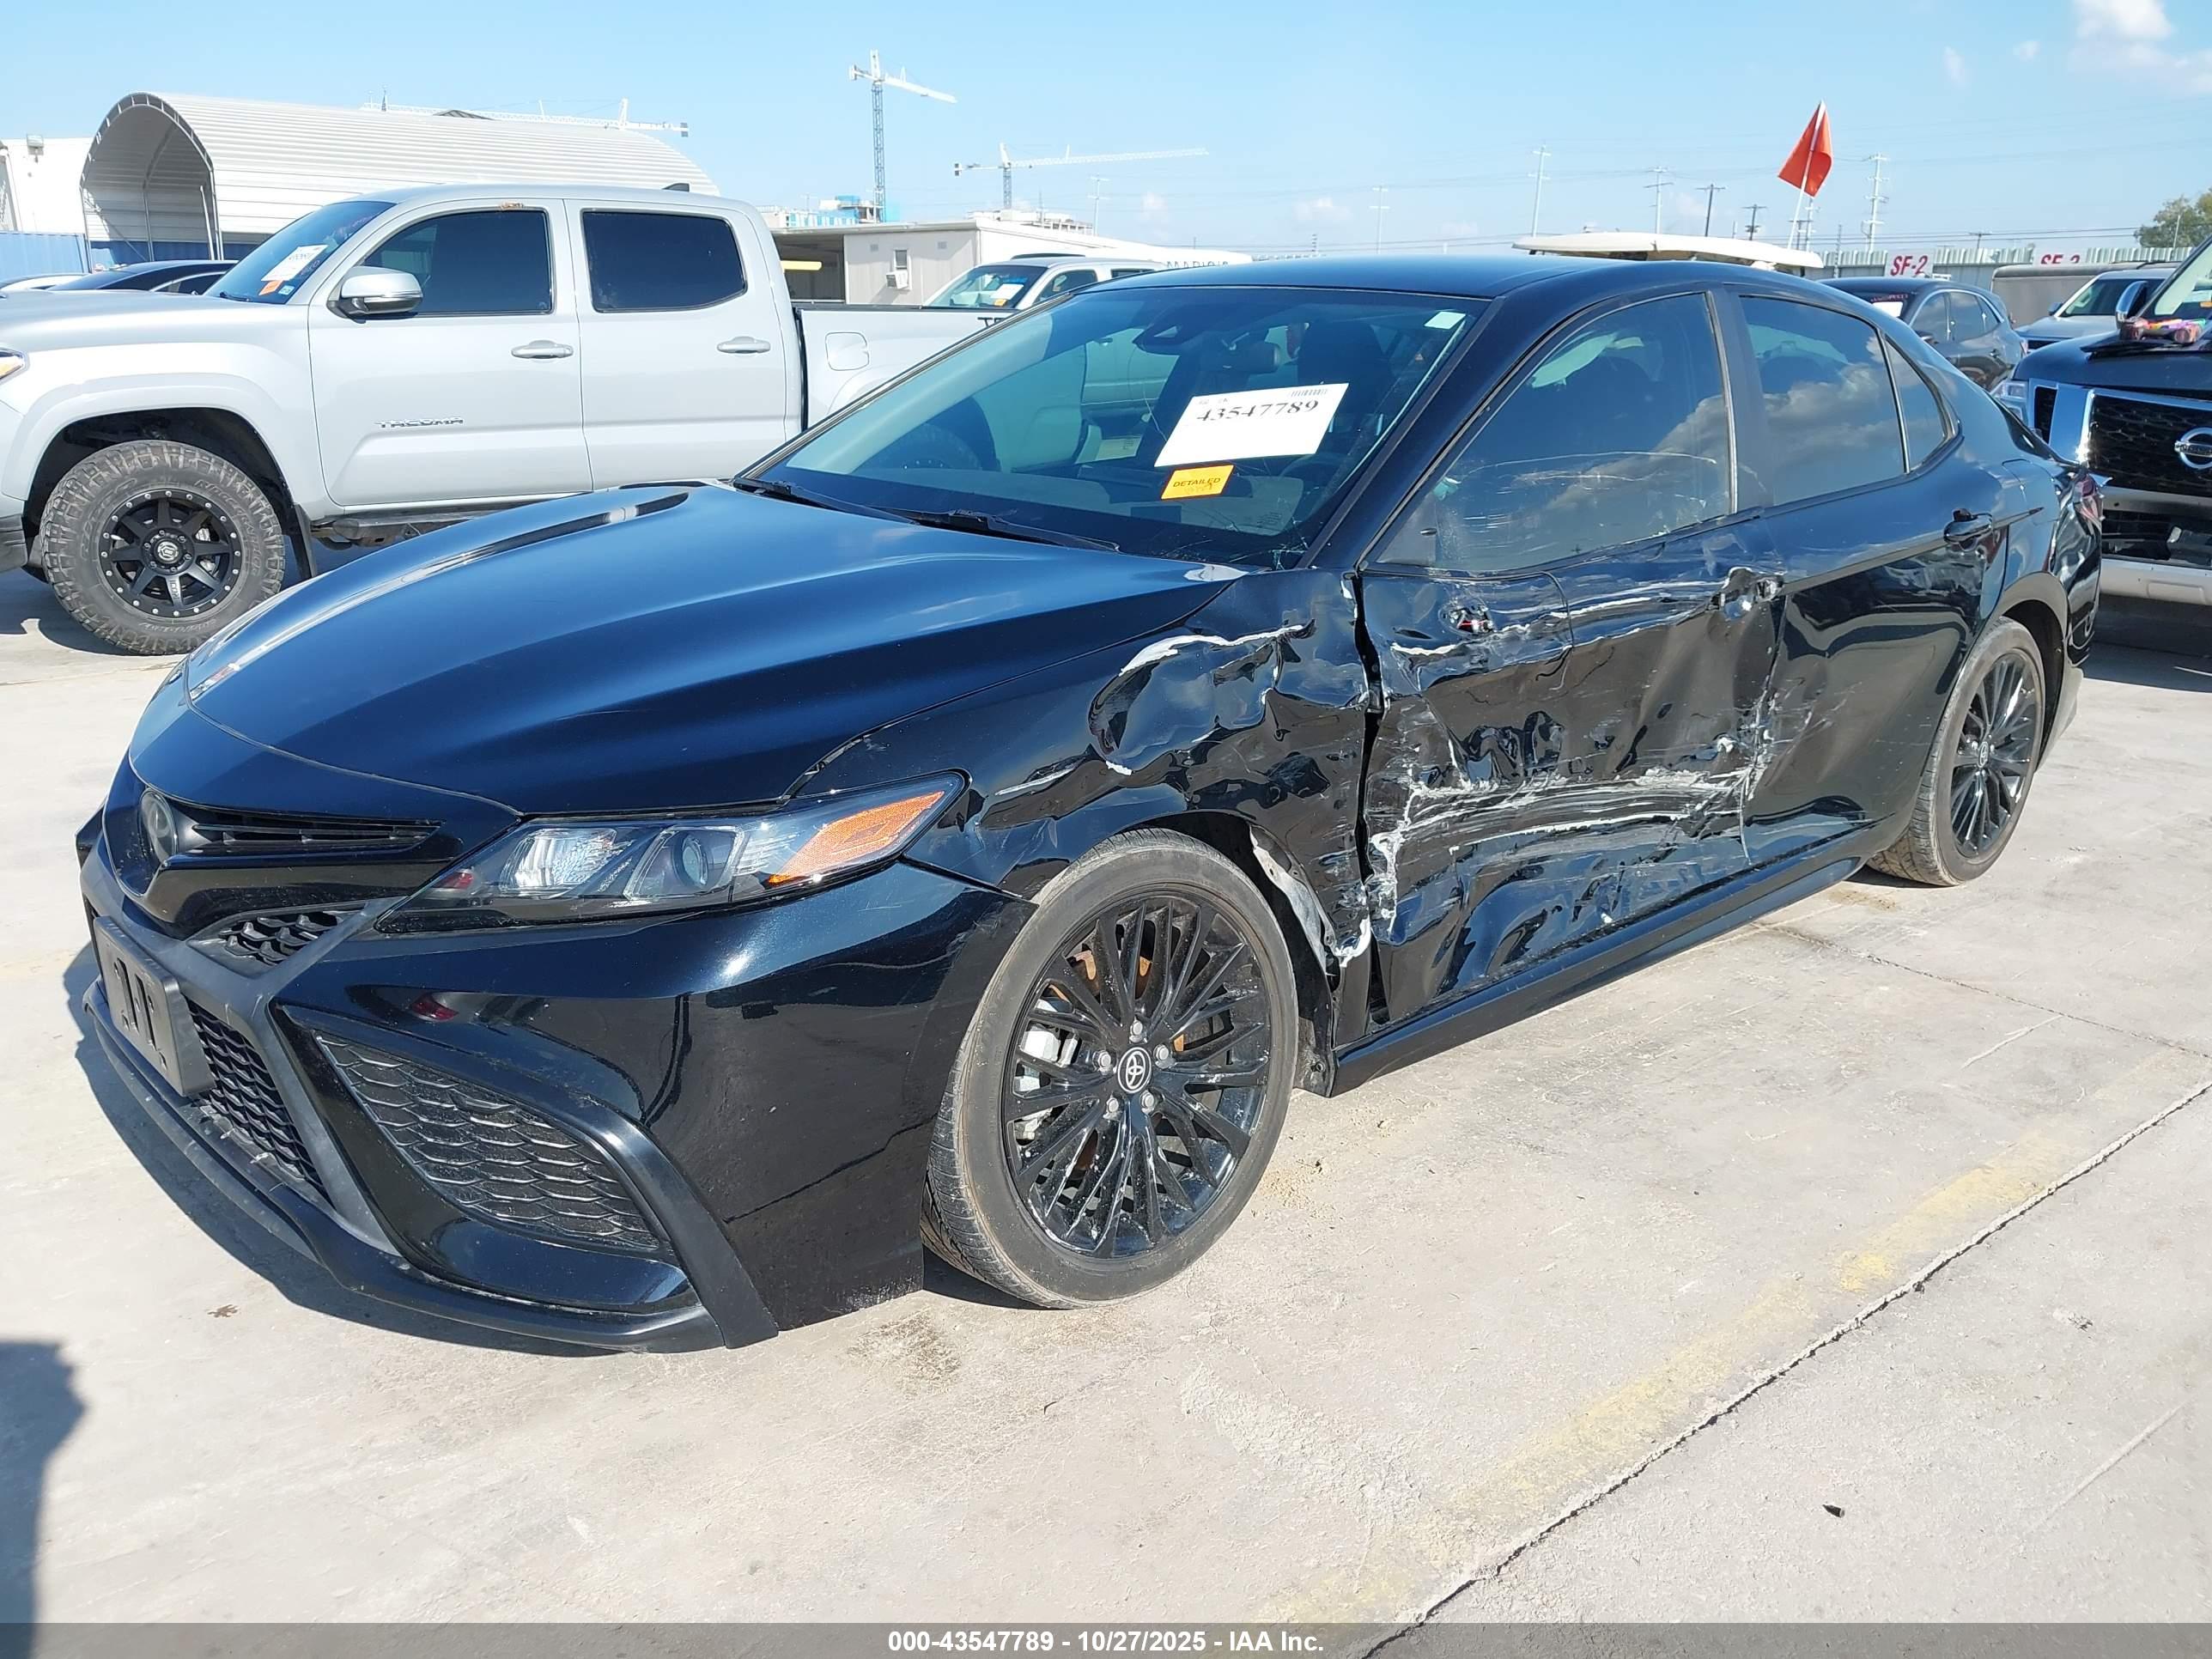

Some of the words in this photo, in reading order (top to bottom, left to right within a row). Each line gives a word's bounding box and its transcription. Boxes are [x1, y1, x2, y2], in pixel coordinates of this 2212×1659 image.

[1890, 255, 1928, 276] SF-2
[1196, 399, 1320, 422] 43547789
[374, 416, 464, 428] TACOMA
[1173, 477, 1221, 488] DETAILED
